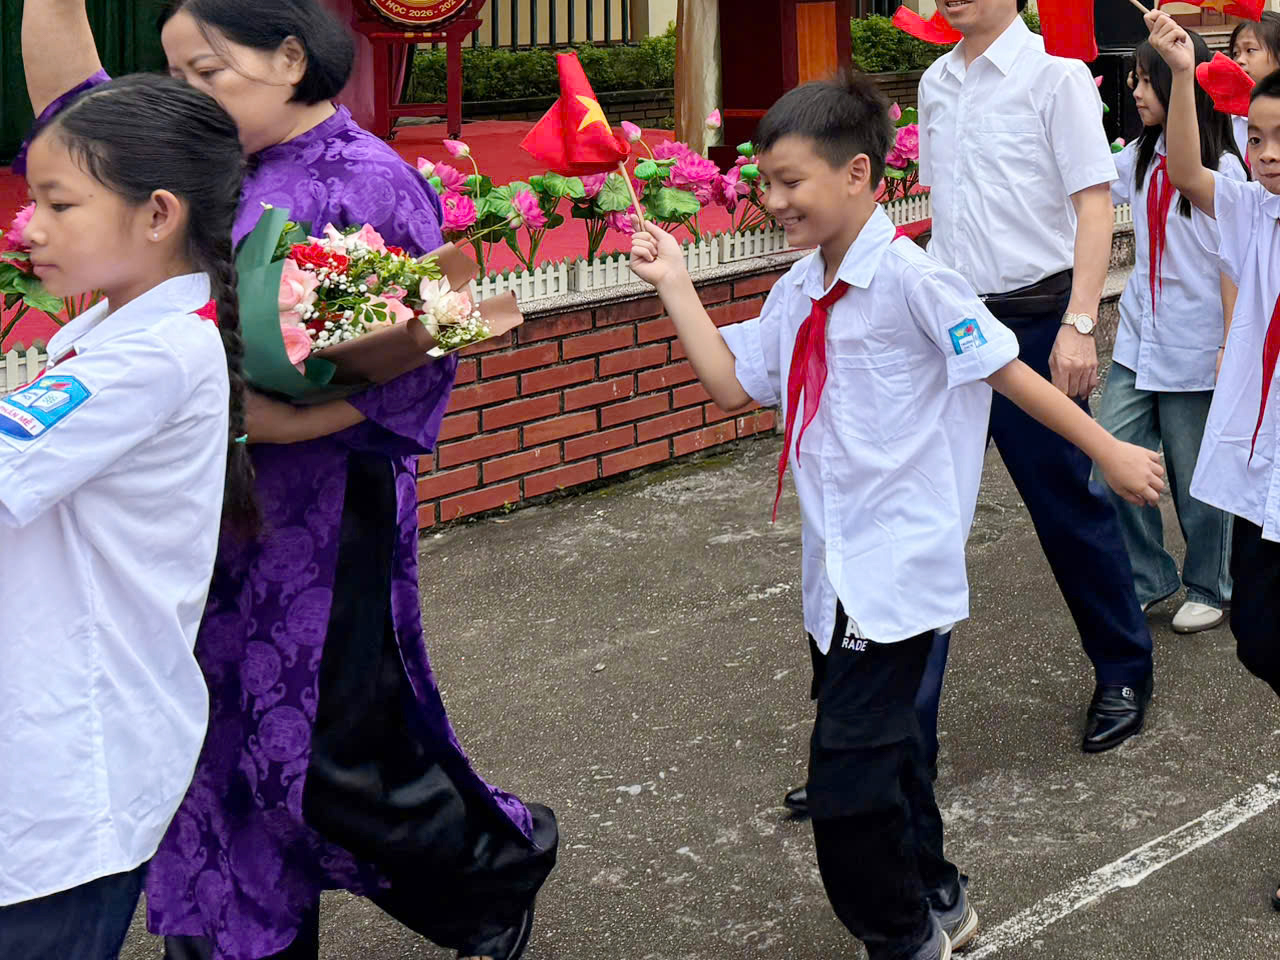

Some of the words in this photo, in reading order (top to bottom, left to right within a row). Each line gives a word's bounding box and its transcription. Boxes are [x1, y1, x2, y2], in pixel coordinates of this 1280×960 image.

[385, 0, 407, 15] HỌC
[408, 9, 434, 17] 2026
[841, 638, 868, 651] RADE
